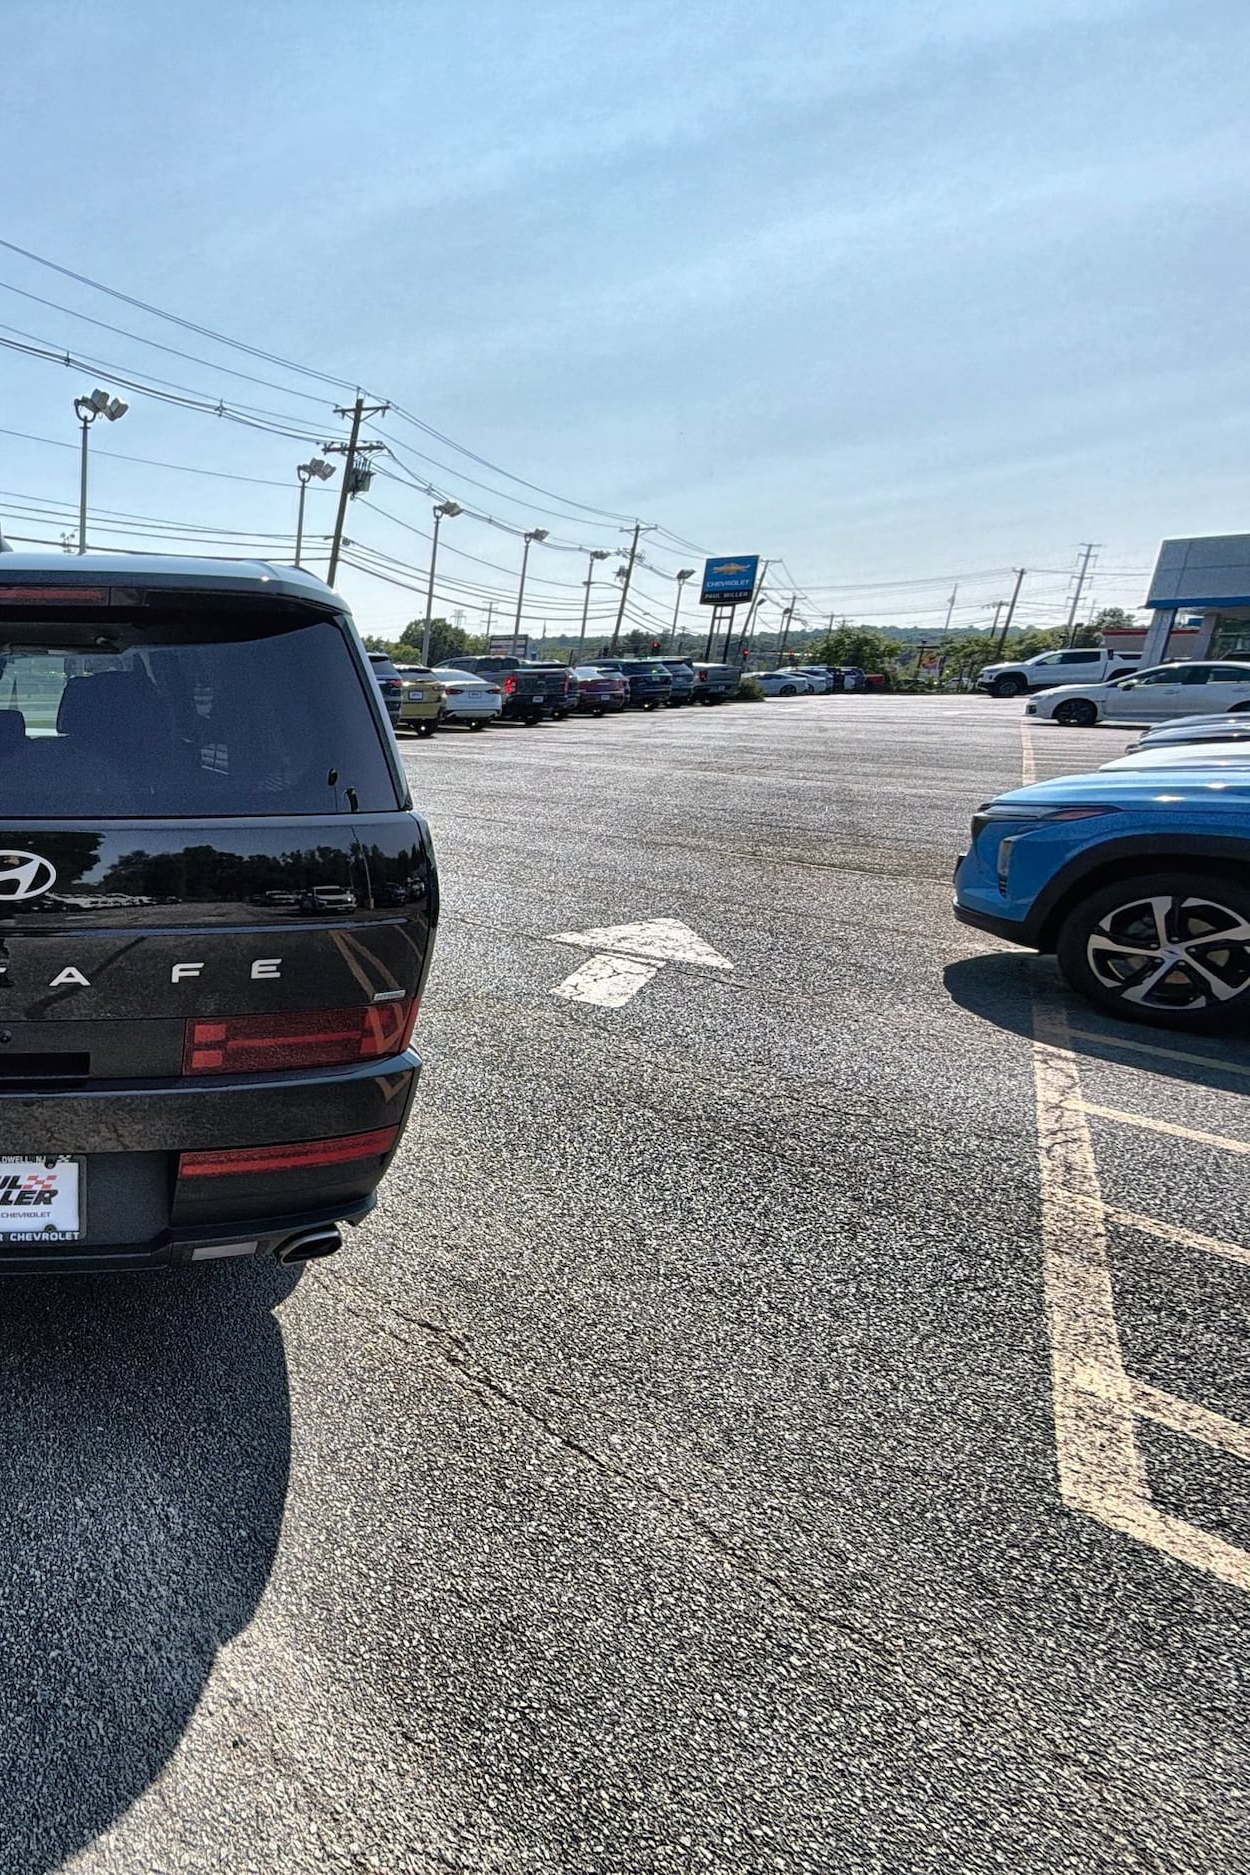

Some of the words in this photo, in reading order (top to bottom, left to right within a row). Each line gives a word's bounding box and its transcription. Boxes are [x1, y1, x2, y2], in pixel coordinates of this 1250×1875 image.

[706, 579, 750, 588] CHEVROLET
[171, 958, 282, 983] FE
[35, 1155, 47, 1163] NJ
[0, 1211, 51, 1219] CHEVROLET
[10, 1231, 80, 1241] CHEVROLET
